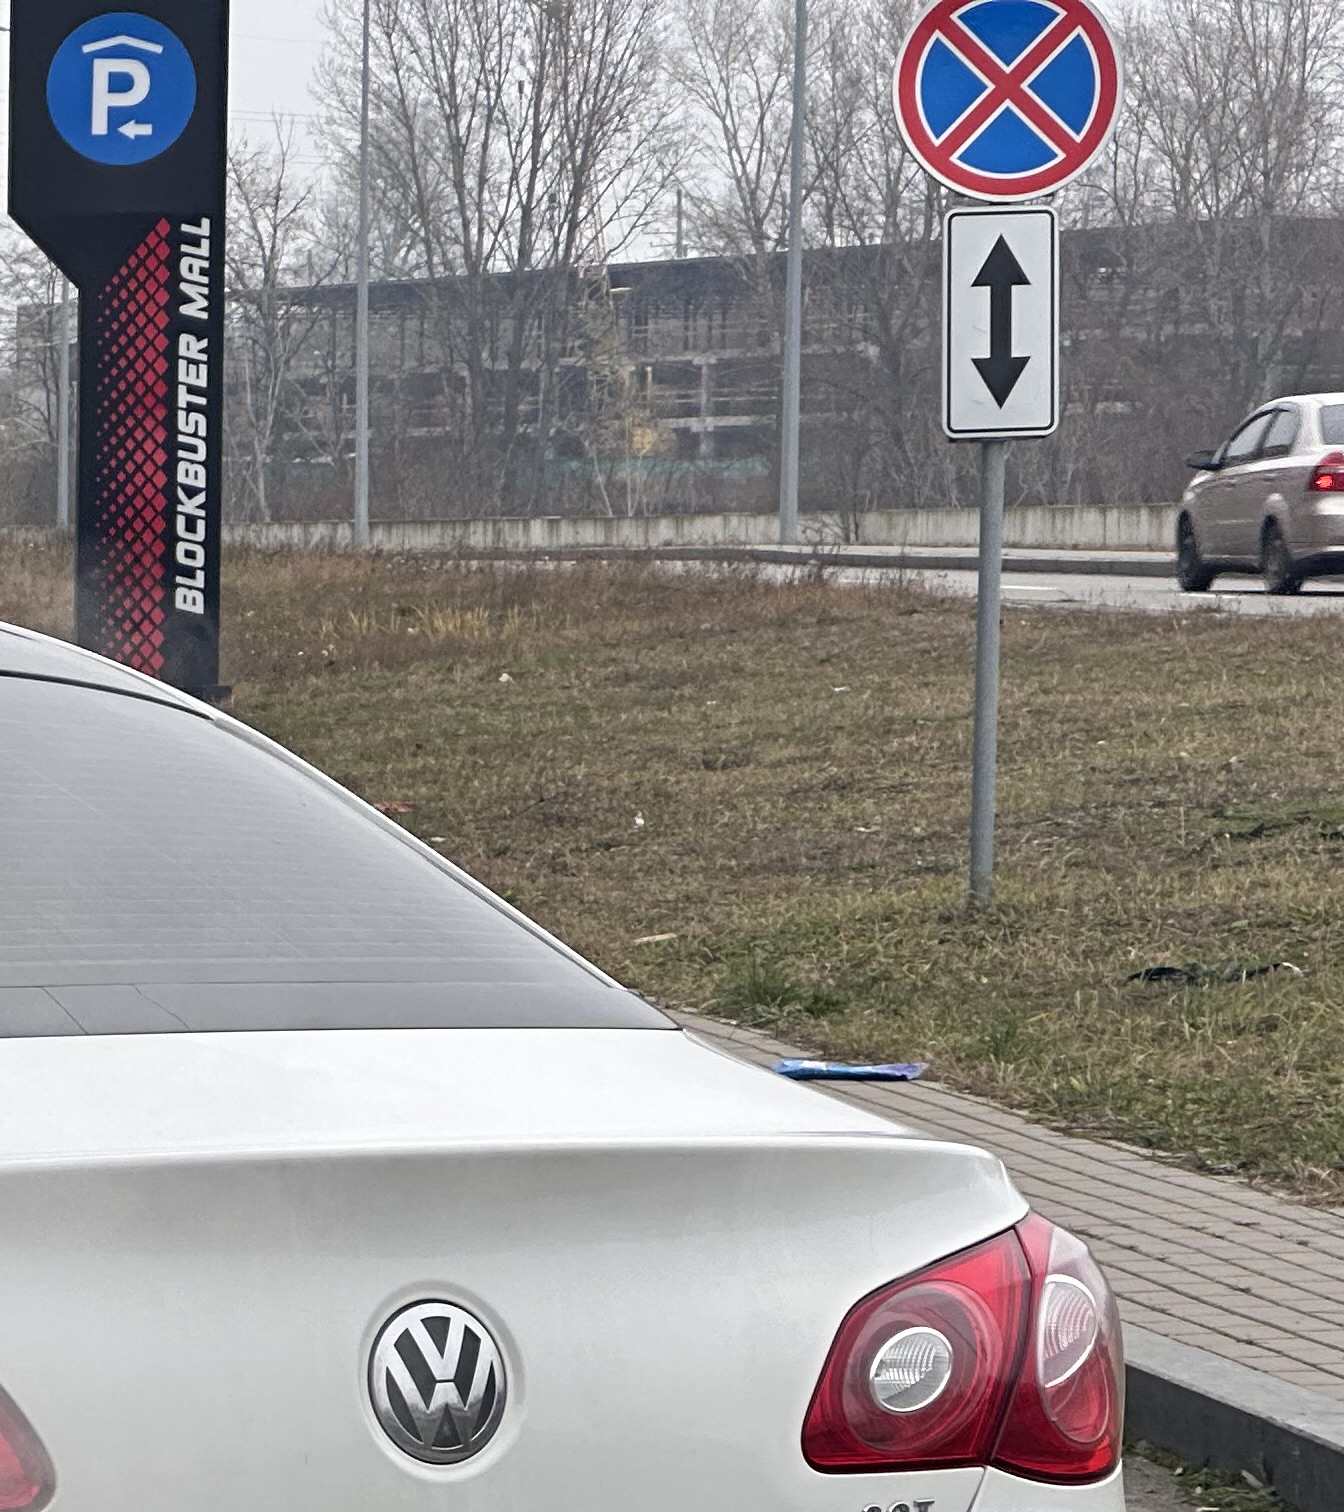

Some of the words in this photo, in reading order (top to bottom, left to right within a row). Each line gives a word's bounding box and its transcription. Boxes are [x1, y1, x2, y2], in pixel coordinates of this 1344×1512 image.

[91, 57, 151, 135] P
[179, 216, 211, 321] MALL
[175, 332, 209, 615] BLOCKBUSTER
